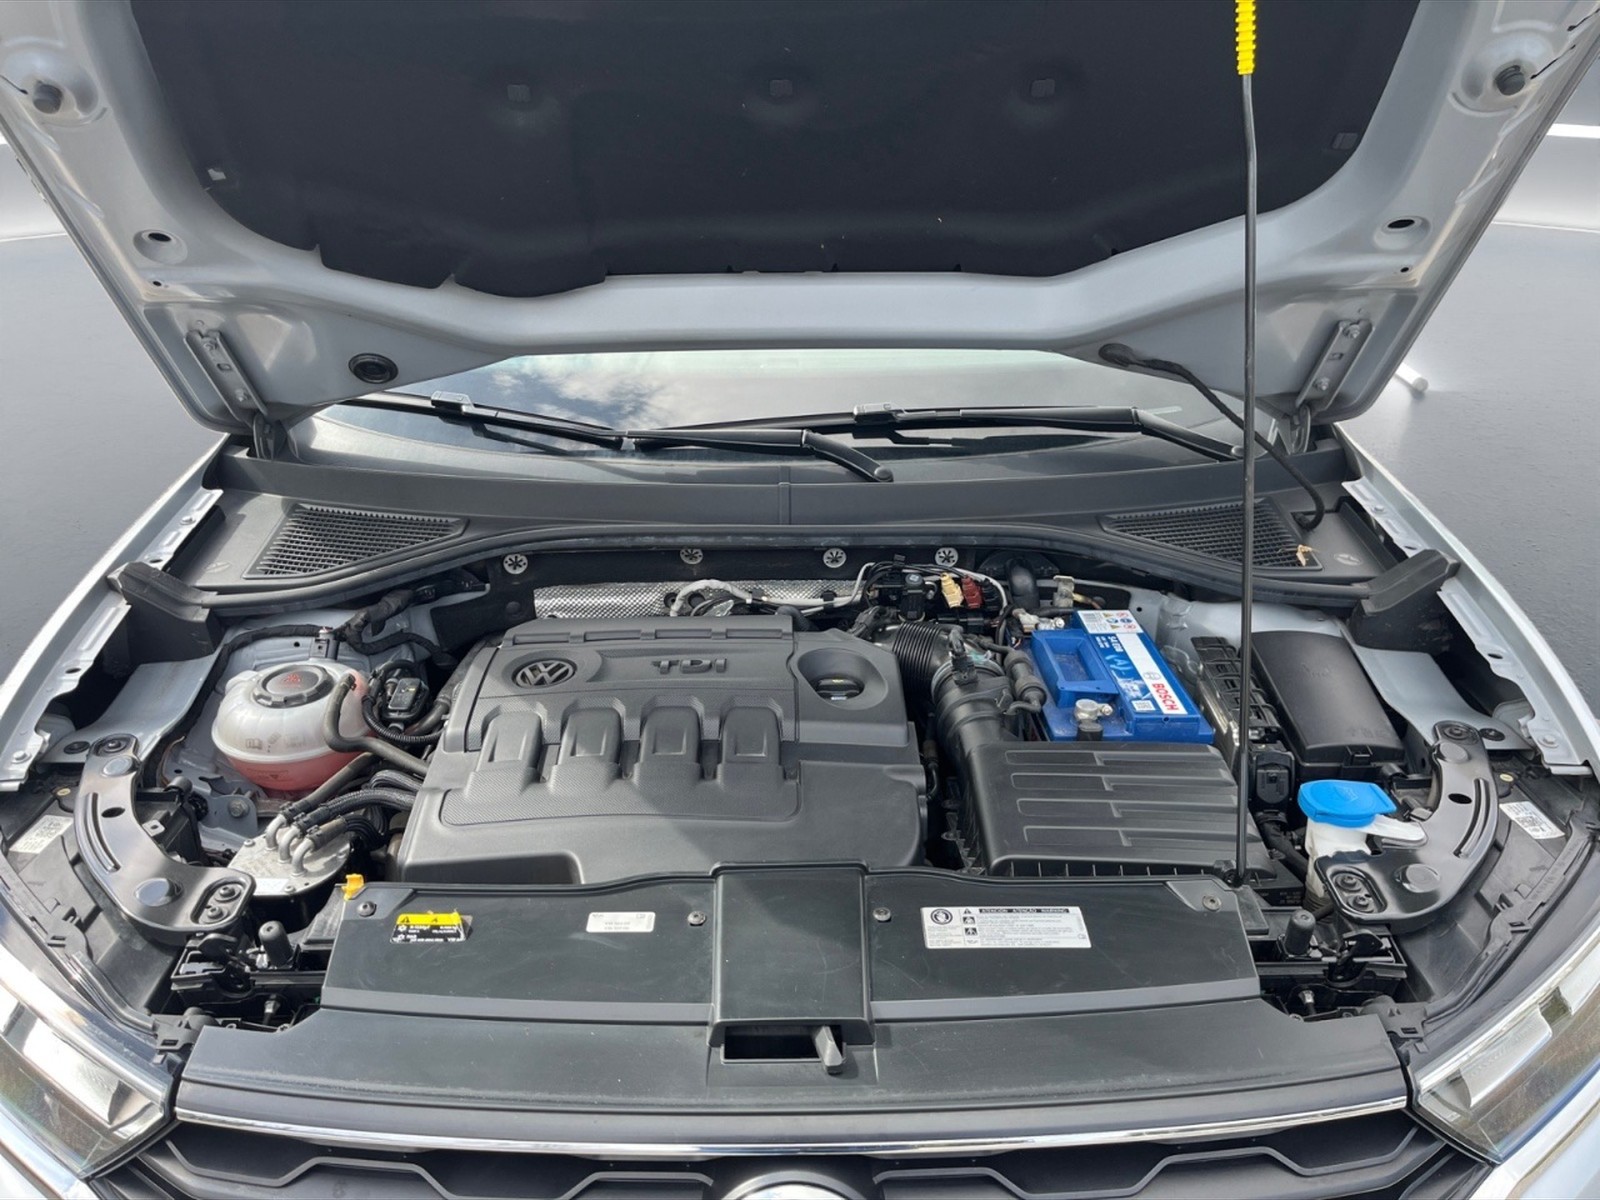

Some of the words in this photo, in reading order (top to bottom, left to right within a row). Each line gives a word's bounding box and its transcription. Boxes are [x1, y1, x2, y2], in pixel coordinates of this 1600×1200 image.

[514, 660, 576, 688] VW
[652, 658, 728, 675] TDI
[1152, 683, 1179, 711] BOSCH
